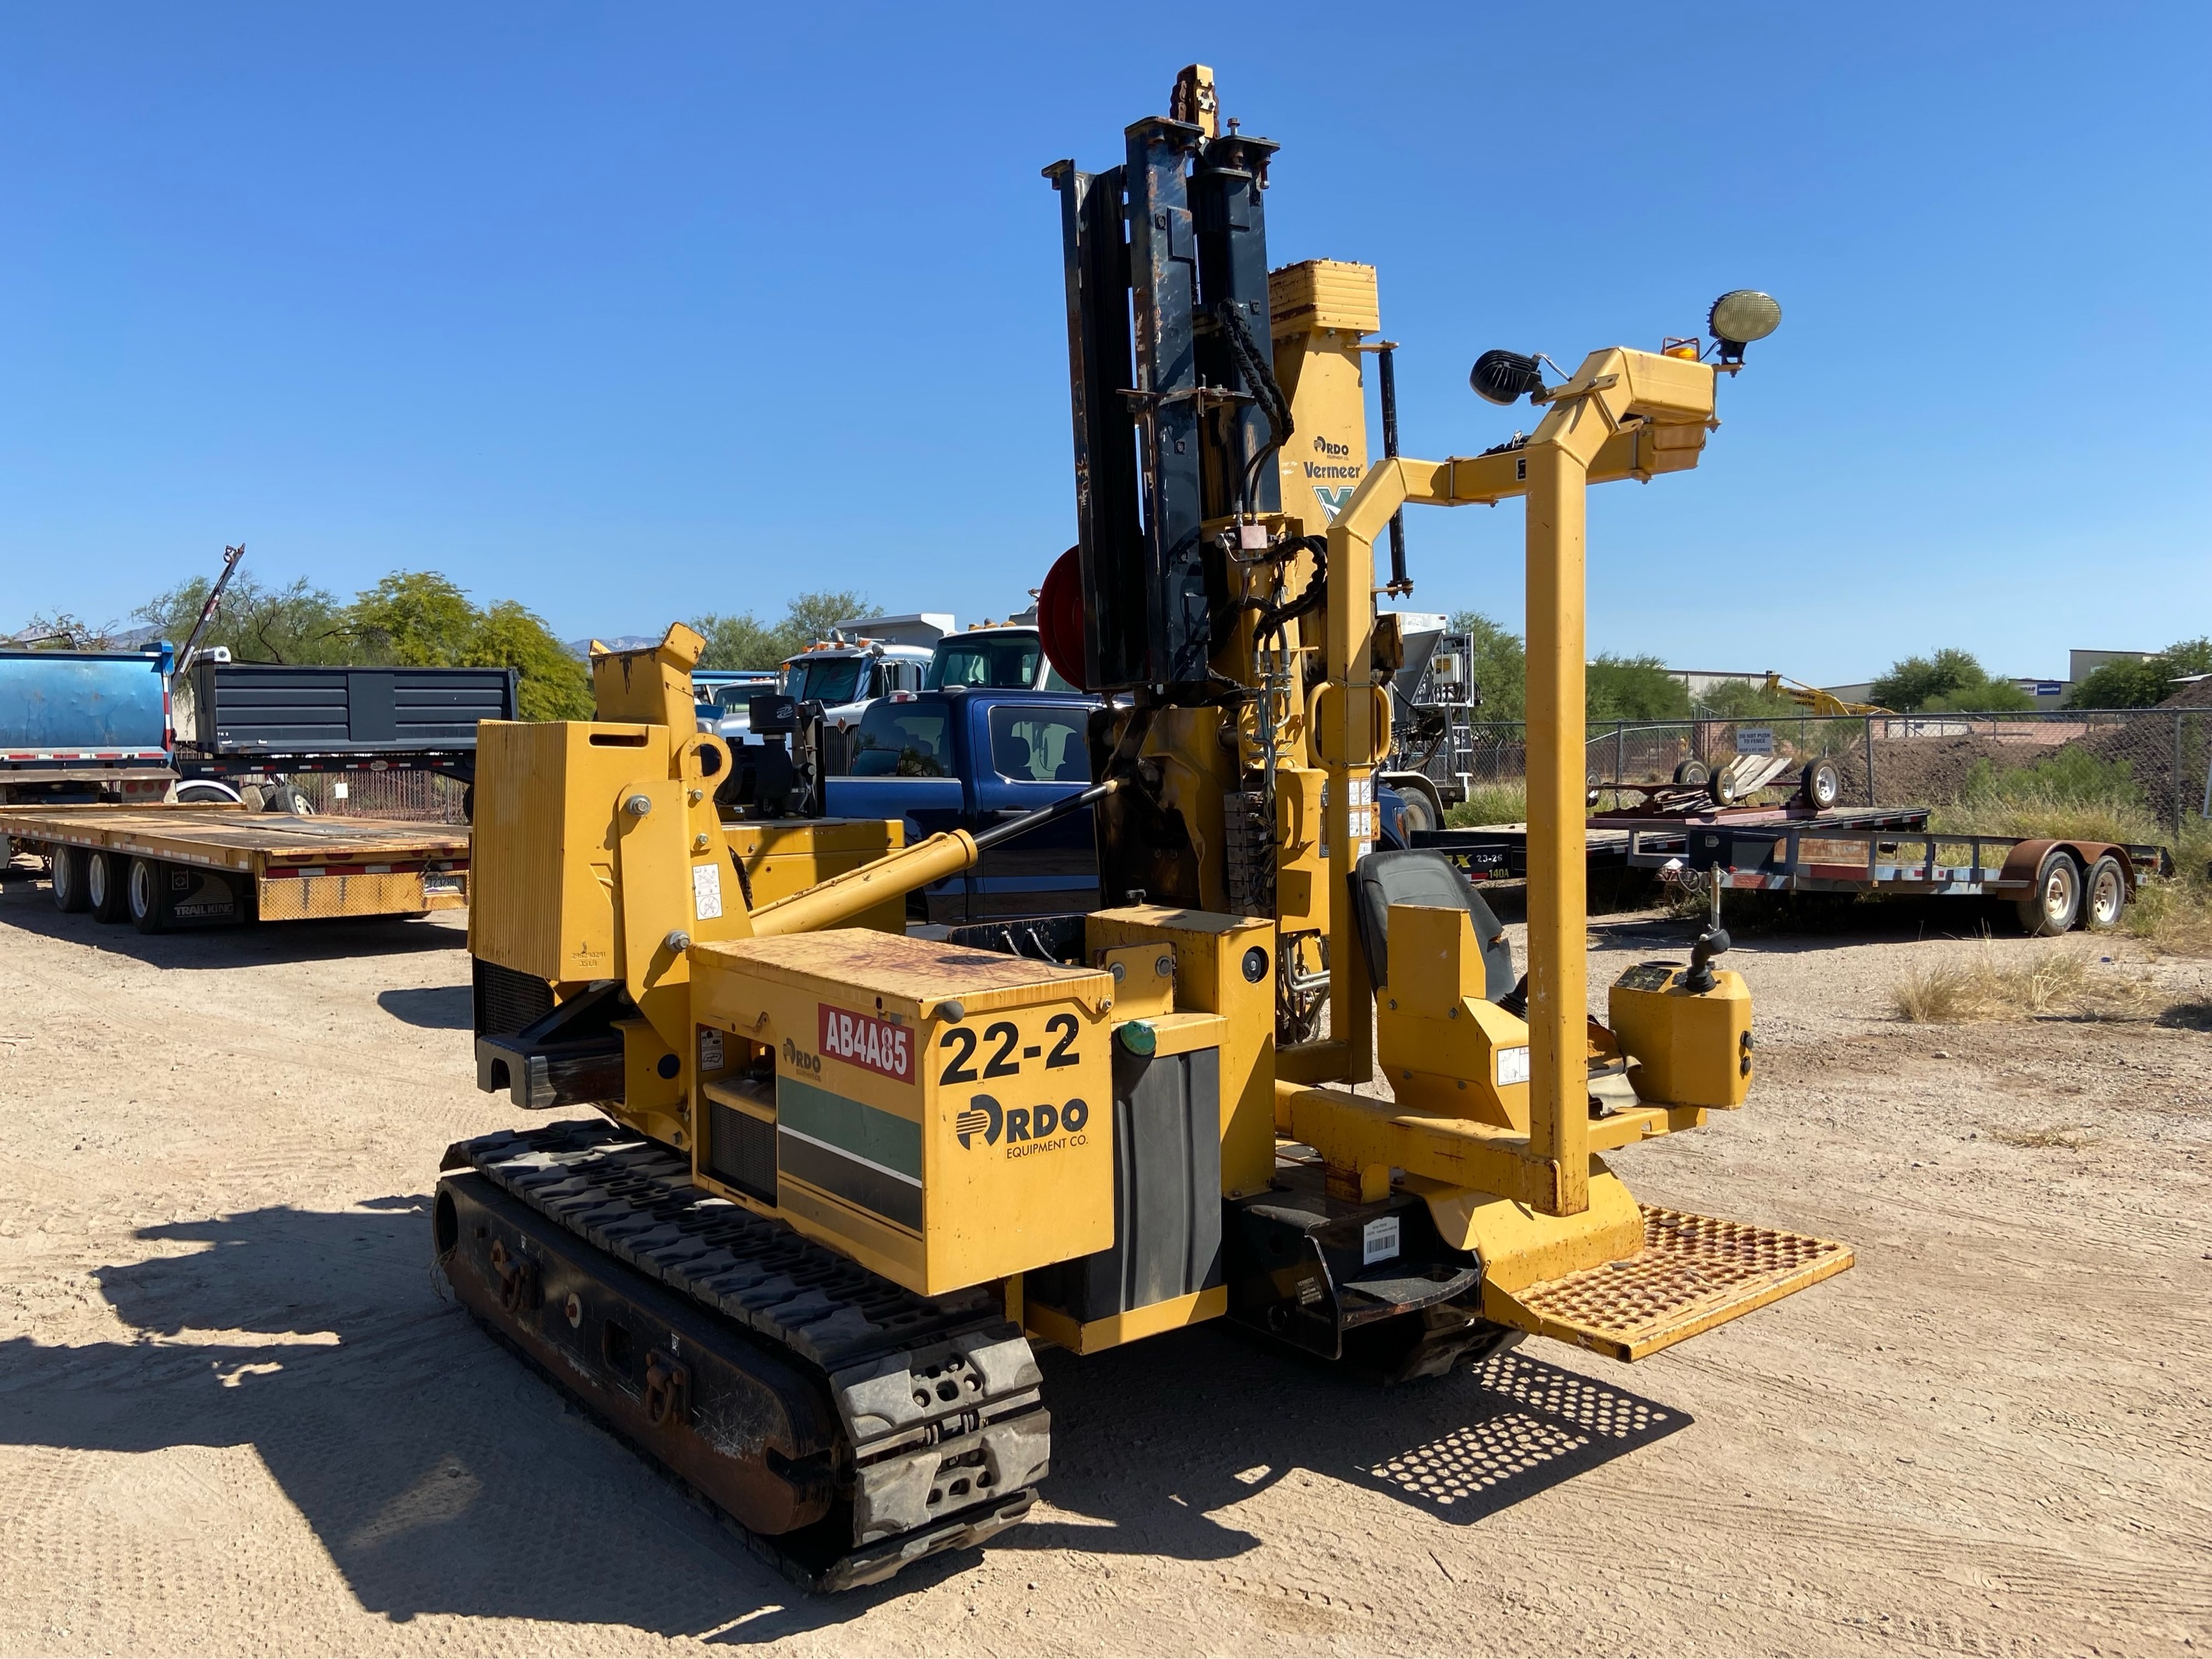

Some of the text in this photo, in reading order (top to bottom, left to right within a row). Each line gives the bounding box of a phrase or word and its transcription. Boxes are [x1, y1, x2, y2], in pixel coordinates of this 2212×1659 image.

[208, 903, 233, 914] KING
[826, 1011, 907, 1075] AB4A85
[939, 1013, 1080, 1086] 22-2
[1006, 1135, 1089, 1159] EQUIPMENT CO.
